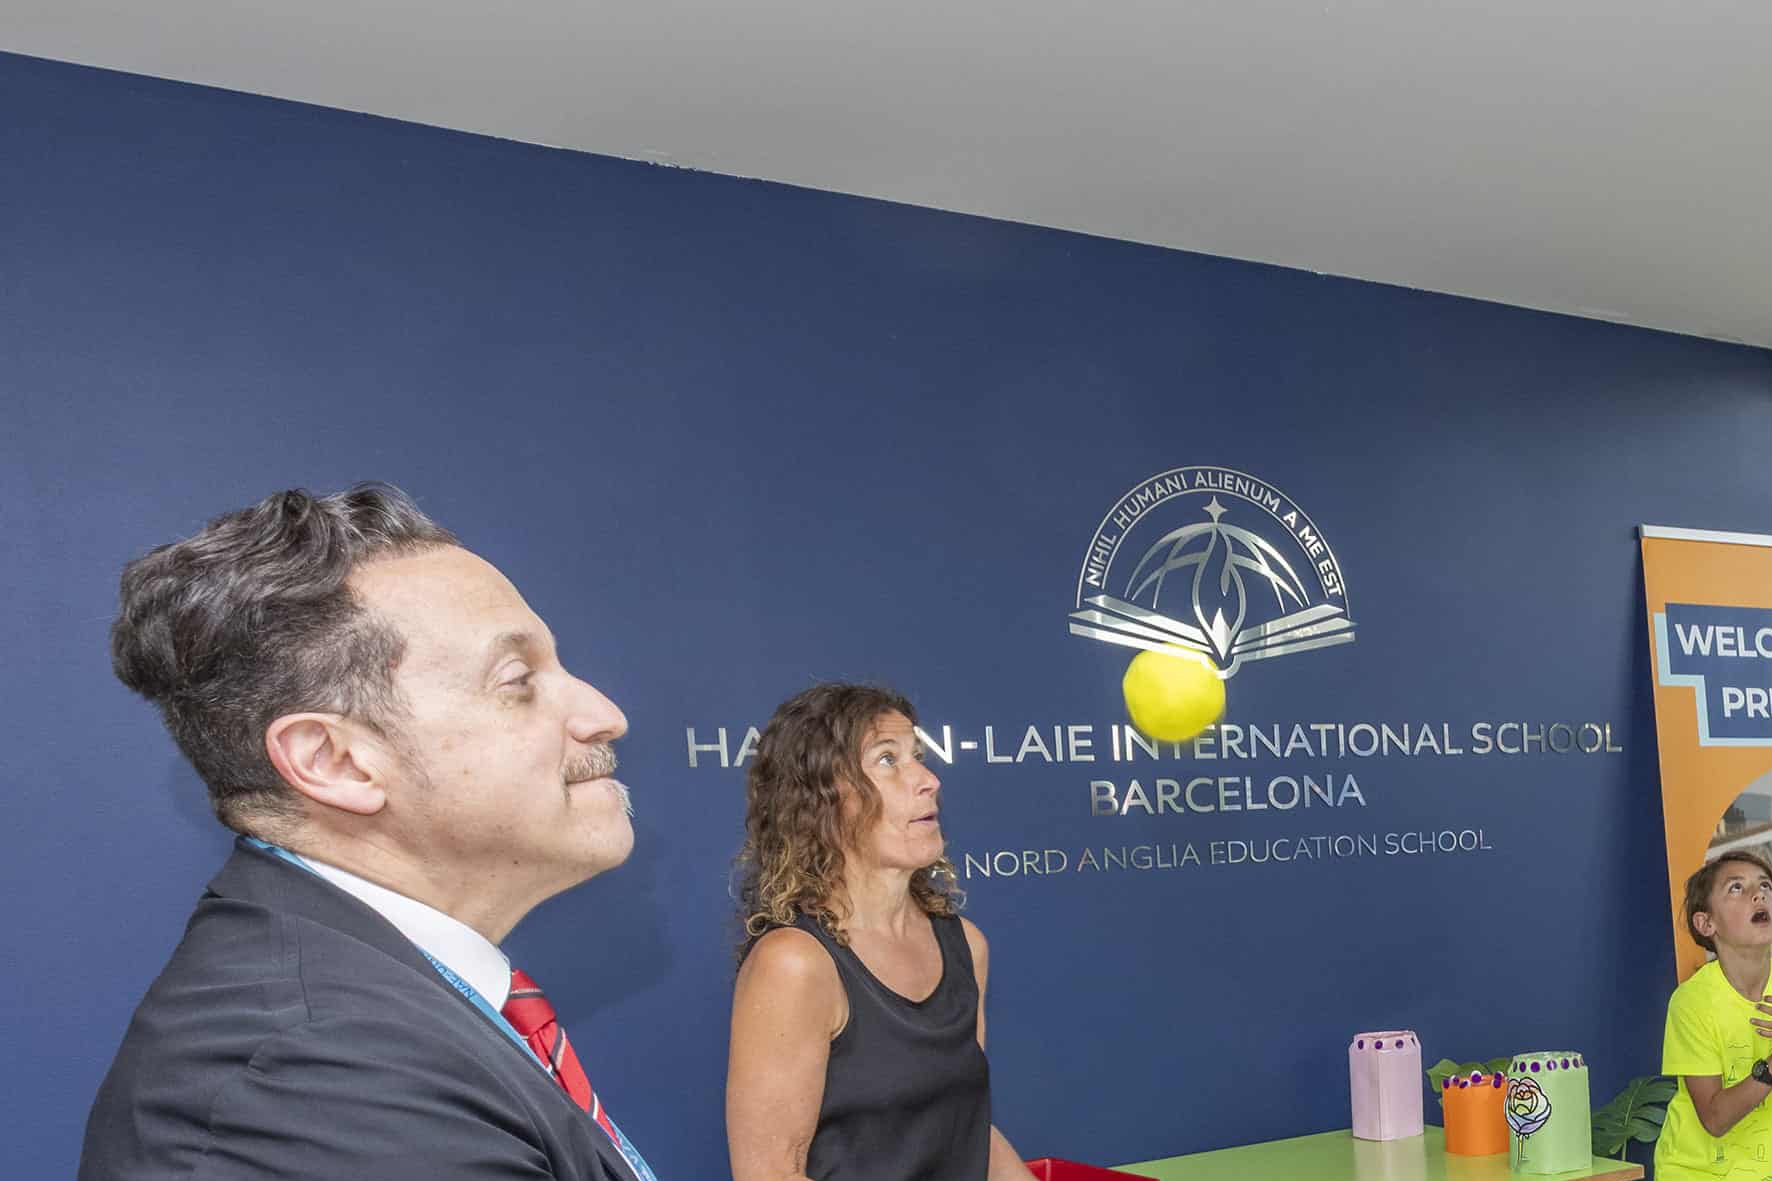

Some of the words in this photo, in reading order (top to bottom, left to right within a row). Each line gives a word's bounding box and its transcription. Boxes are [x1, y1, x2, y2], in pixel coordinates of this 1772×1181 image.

[1085, 530, 1117, 588] NIHIL
[1113, 473, 1188, 530] HUMANI
[1195, 471, 1281, 513] ALIENUM
[1282, 511, 1299, 529] A
[1299, 525, 1325, 557] ME
[1317, 560, 1343, 597] EST
[1471, 721, 1623, 756] SCHOOL
[1089, 774, 1367, 817] BARCELONA
[964, 849, 1068, 881] NORD
[1076, 842, 1201, 873] ANGLIA
[1209, 833, 1378, 866] EDUCATION
[1384, 828, 1493, 856] SCHOOL
